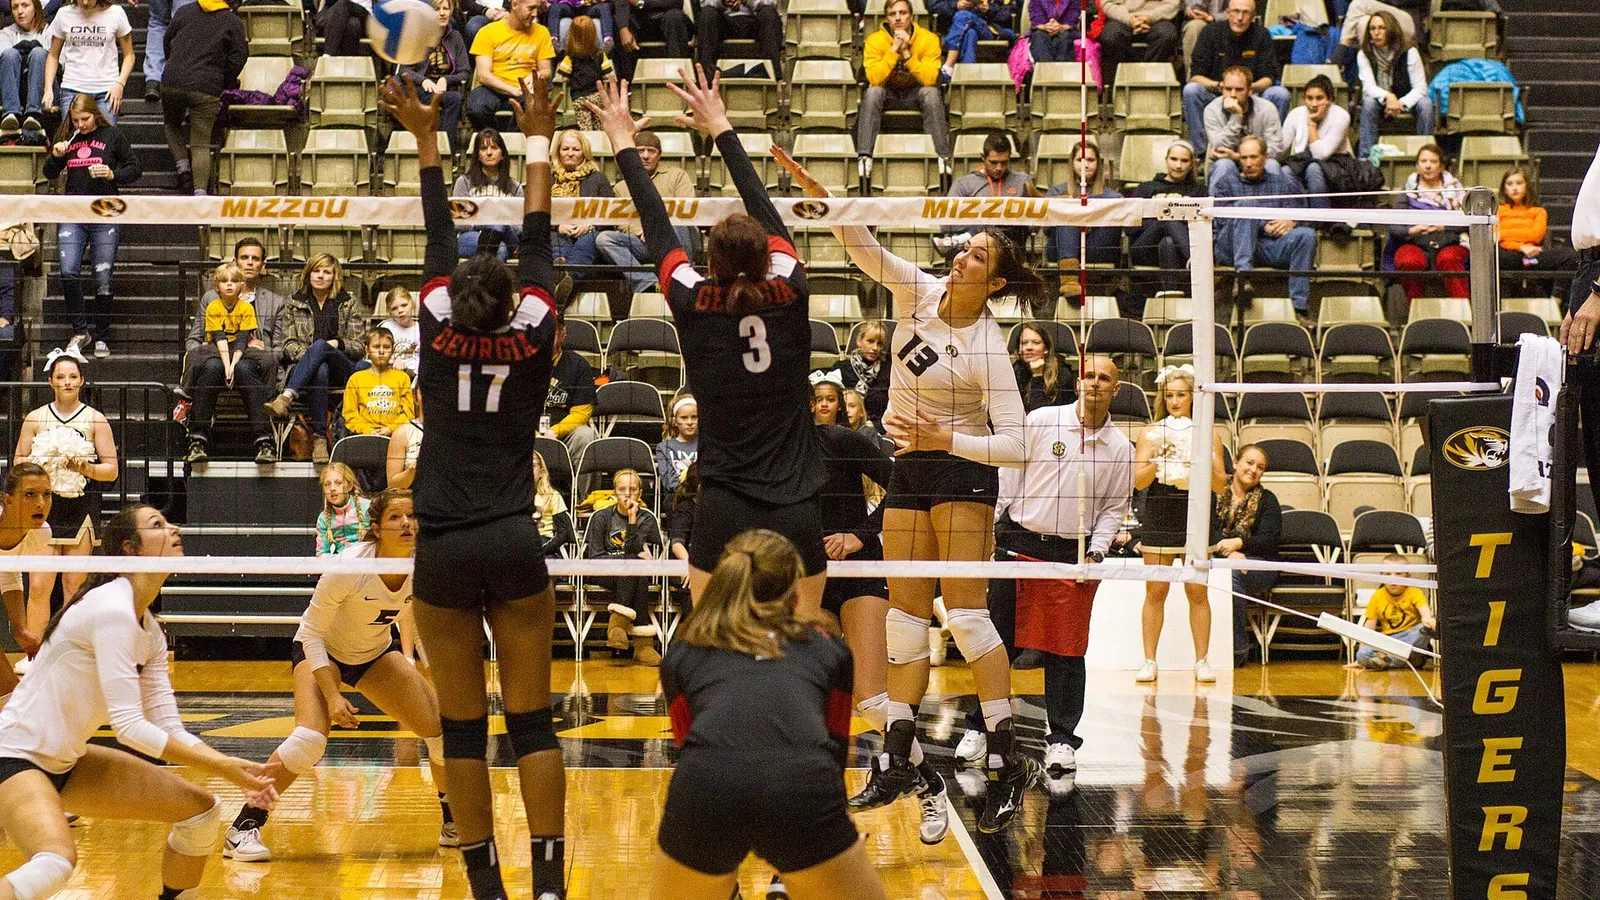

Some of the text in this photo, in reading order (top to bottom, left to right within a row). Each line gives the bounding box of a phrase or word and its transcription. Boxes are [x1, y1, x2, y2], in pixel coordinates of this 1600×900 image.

[70, 26, 106, 34] ONE
[221, 199, 349, 218] MIZZOU
[922, 199, 1050, 219] MIZZOU
[431, 328, 538, 361] GEORGIA
[739, 315, 772, 373] 3
[897, 333, 939, 377] 13
[458, 364, 510, 412] 17
[370, 609, 400, 625] 5
[1469, 532, 1530, 900] TIGERS
